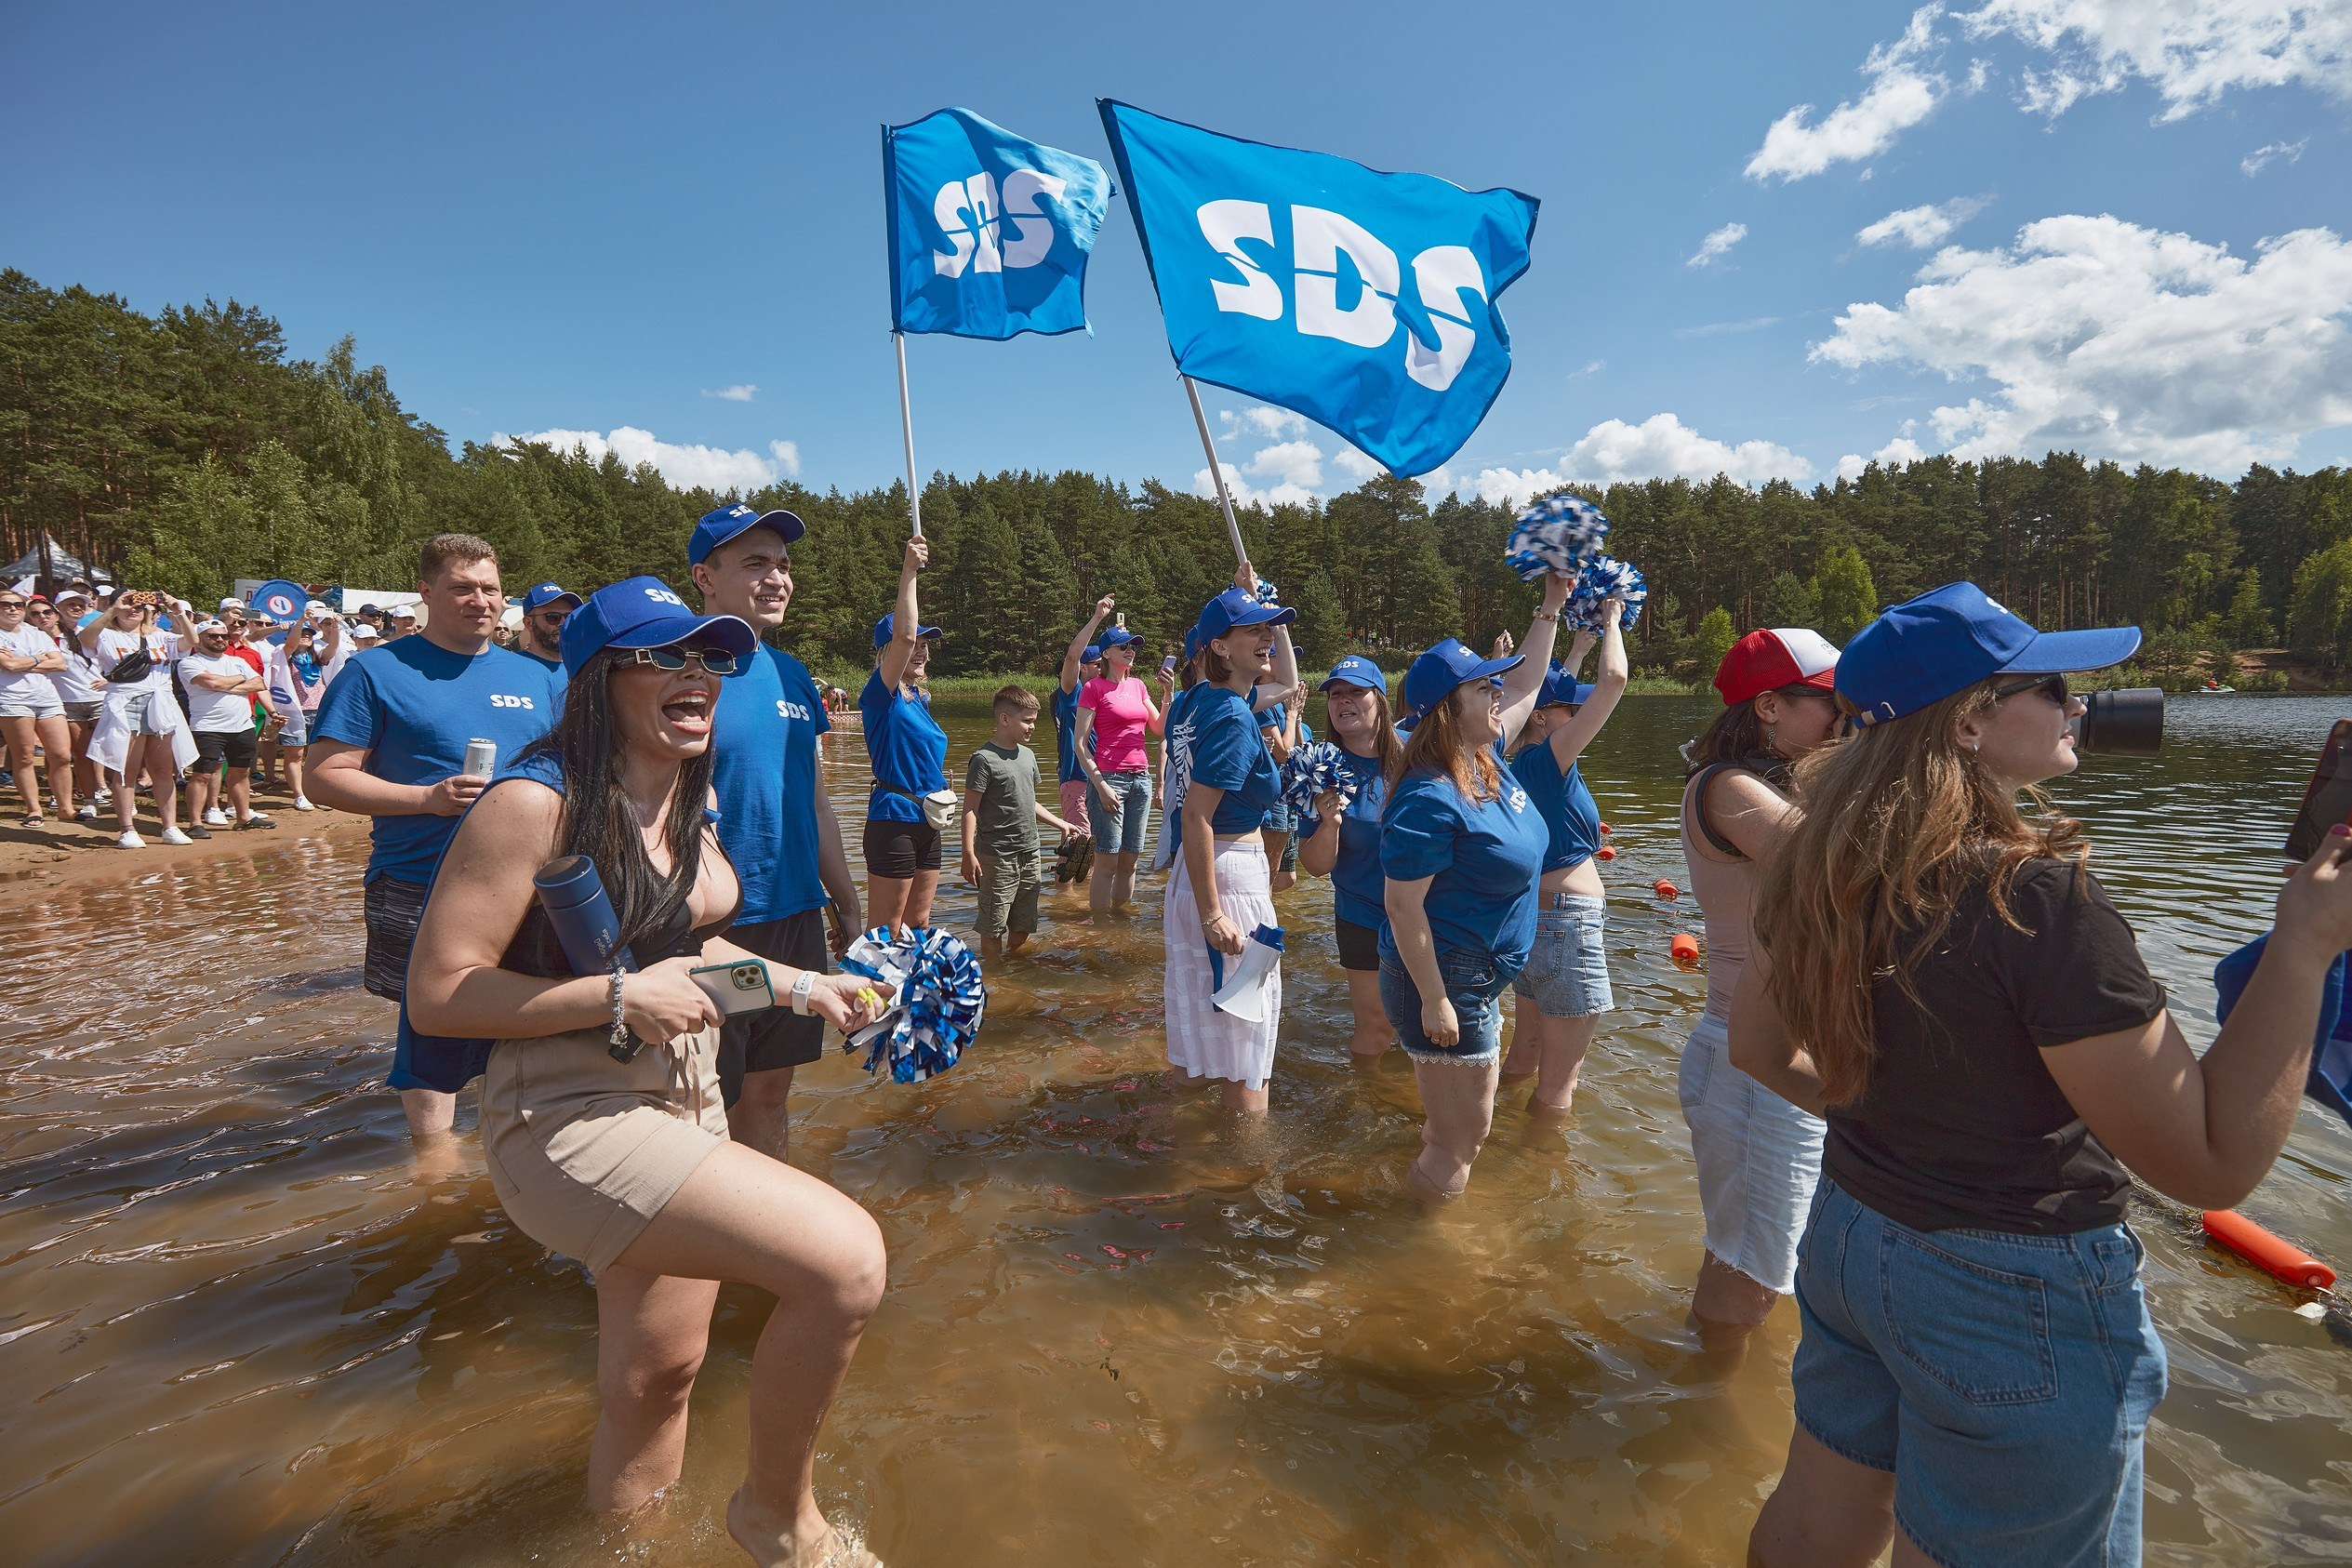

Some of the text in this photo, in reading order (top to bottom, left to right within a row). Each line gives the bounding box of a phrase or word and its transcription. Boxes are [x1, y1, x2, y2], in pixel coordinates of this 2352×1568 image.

[933, 168, 1068, 279] SDS
[1196, 198, 1489, 392] SDS
[729, 504, 754, 518] SD
[644, 588, 692, 612] SD
[489, 694, 535, 711] SDS
[776, 699, 811, 723] SDS
